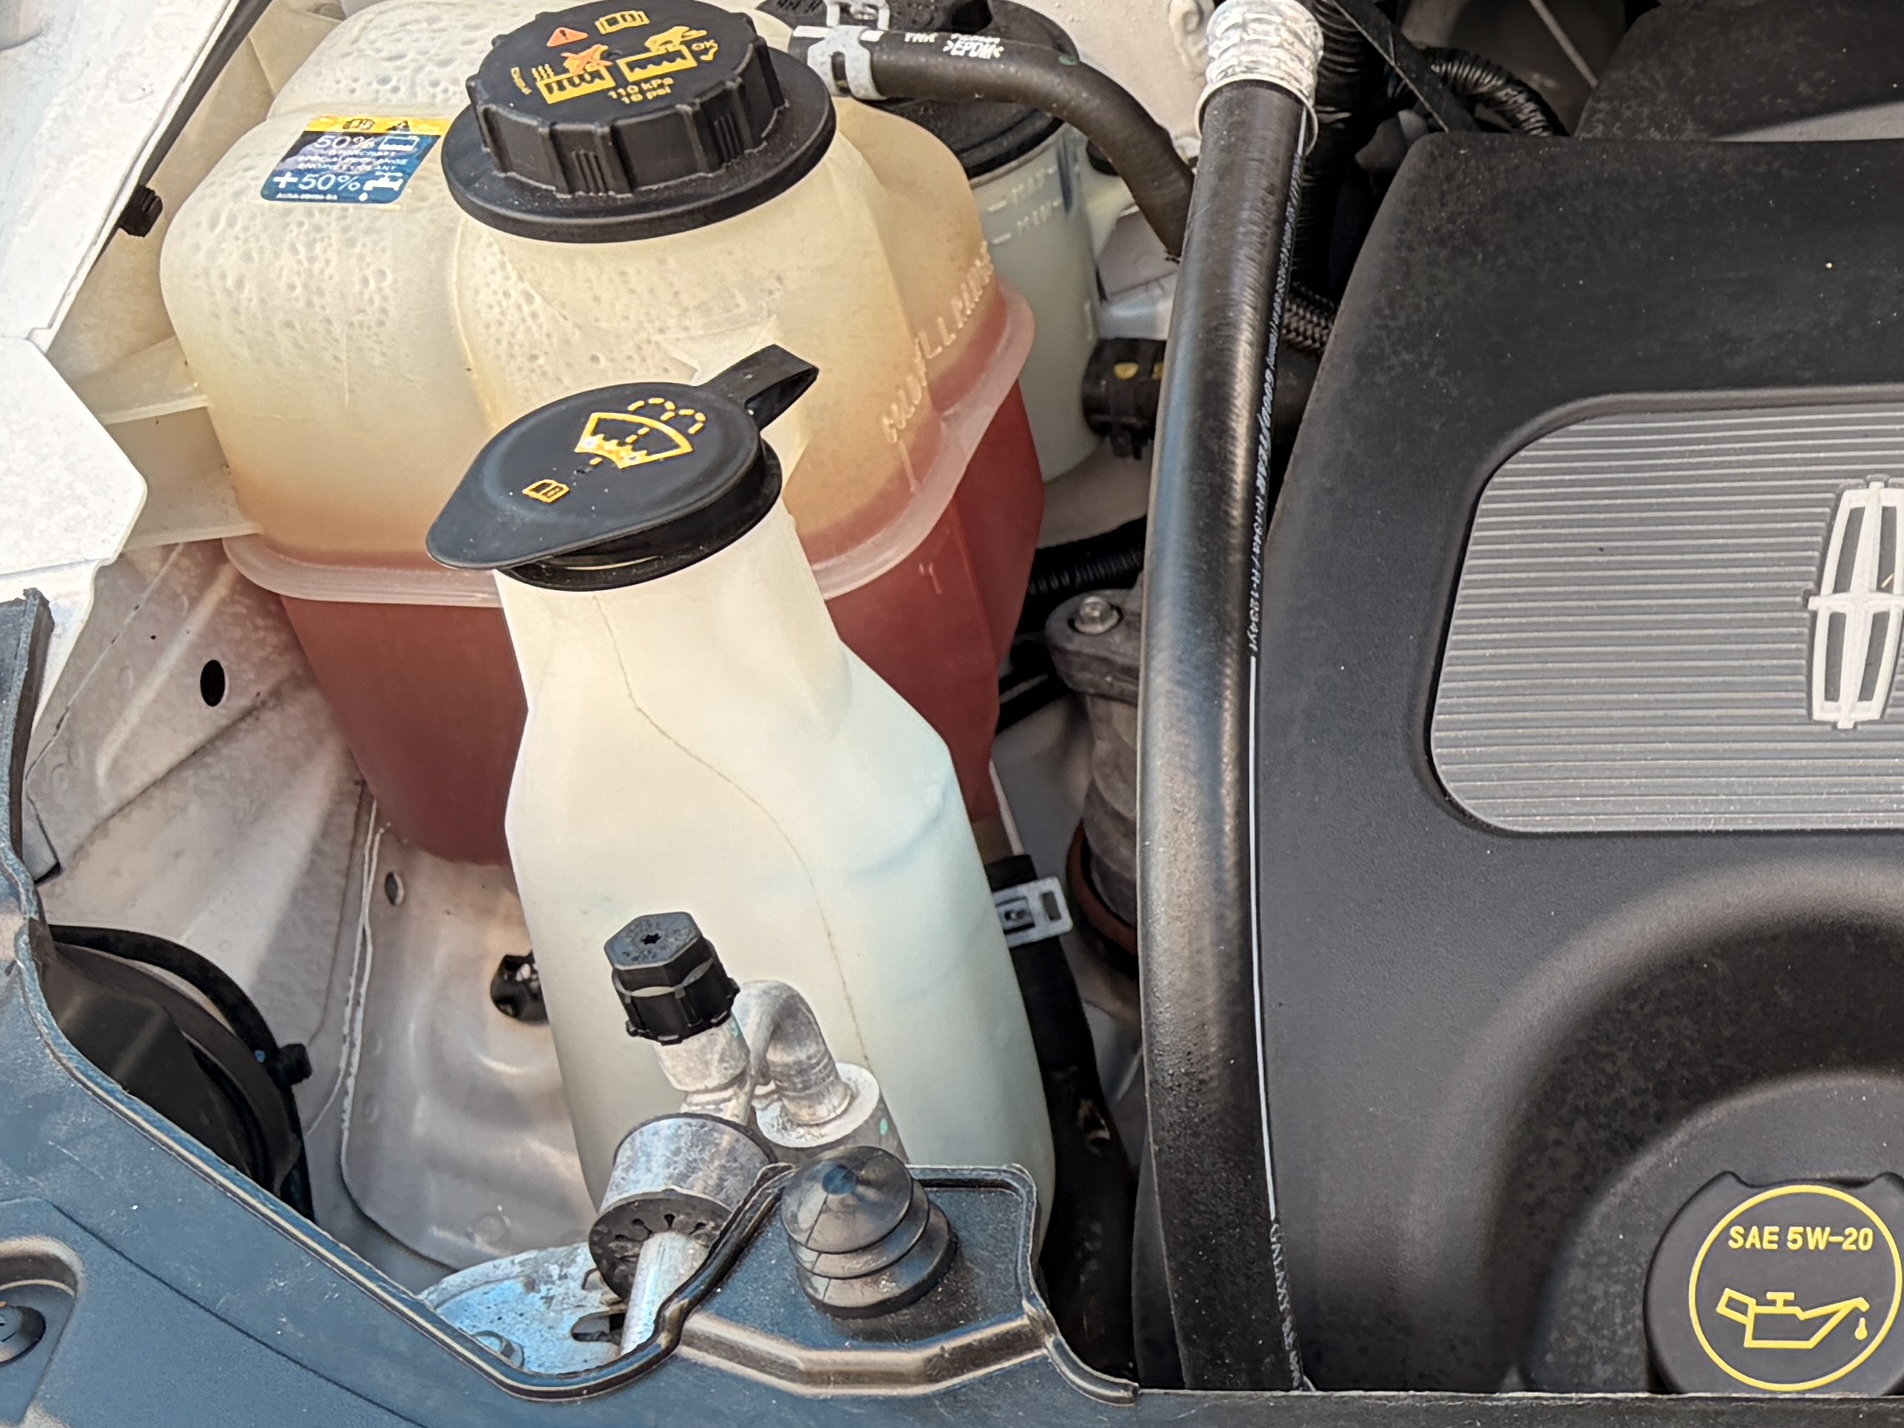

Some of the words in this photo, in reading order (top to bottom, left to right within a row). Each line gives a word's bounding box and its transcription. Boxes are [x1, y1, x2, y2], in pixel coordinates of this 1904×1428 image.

[608, 84, 640, 99] 110
[641, 77, 675, 92] kPa
[1728, 1226, 1779, 1249] SAE
[1786, 1226, 1875, 1251] 5W-20
